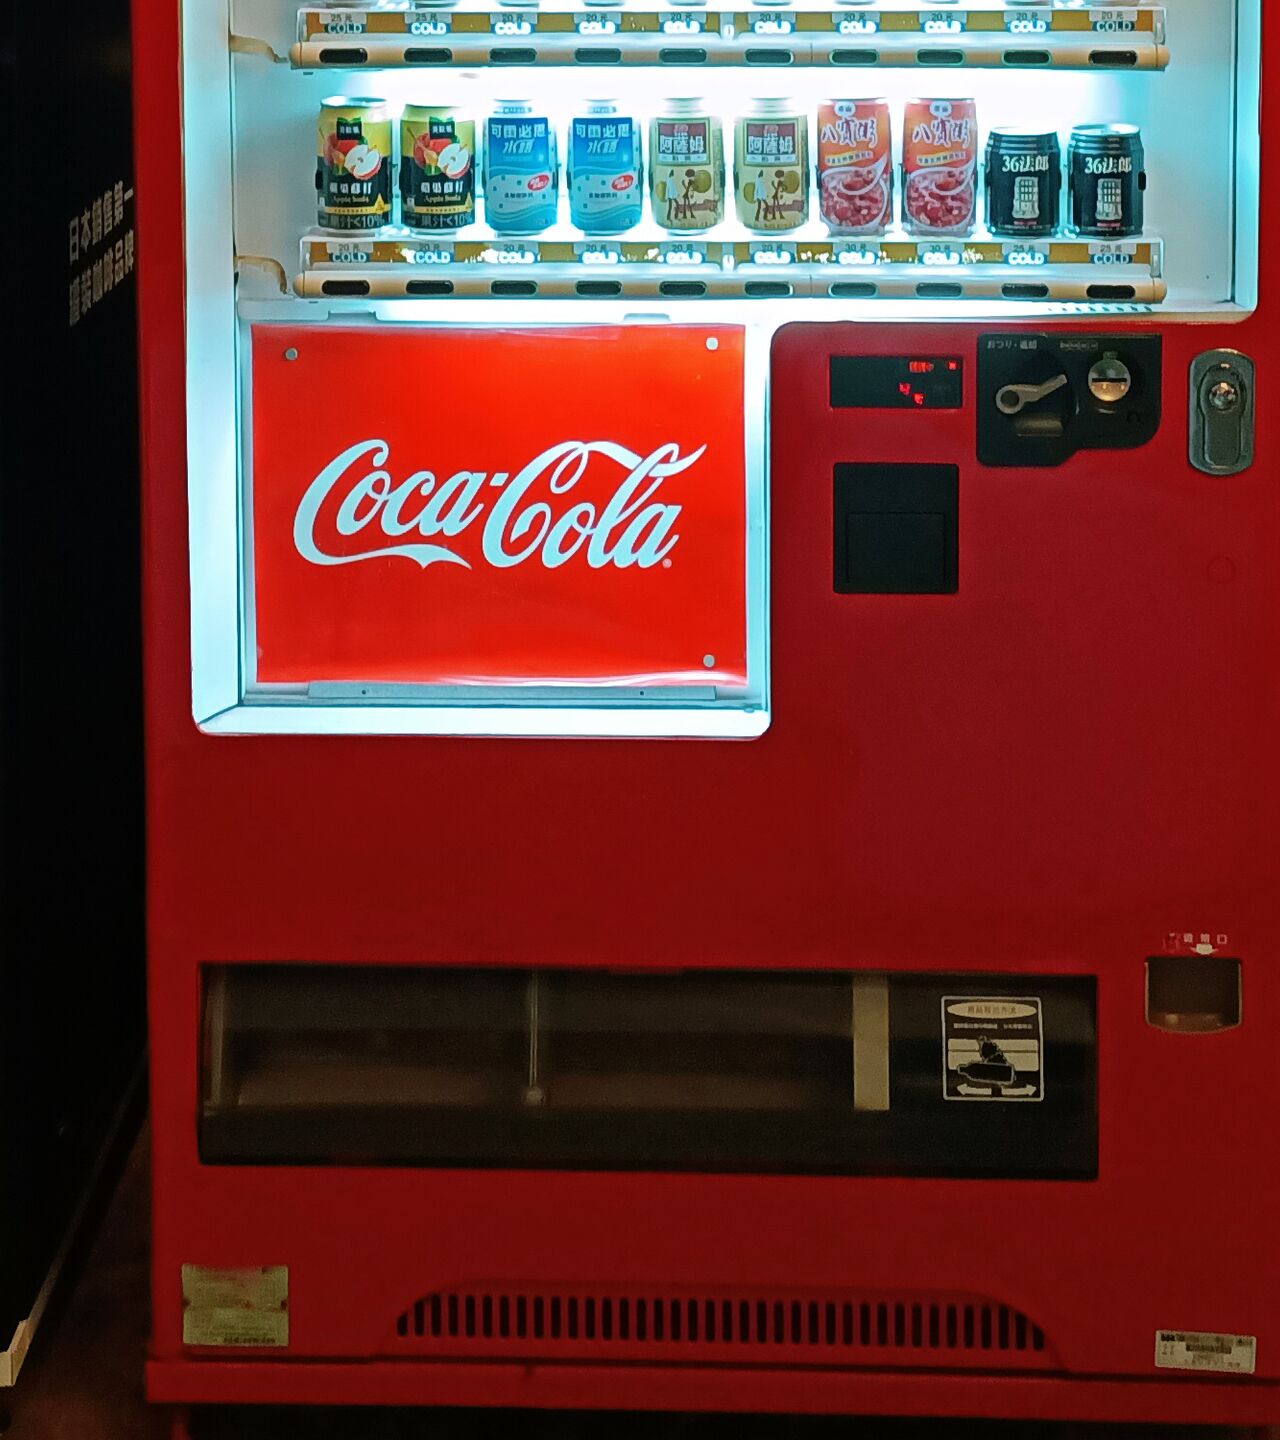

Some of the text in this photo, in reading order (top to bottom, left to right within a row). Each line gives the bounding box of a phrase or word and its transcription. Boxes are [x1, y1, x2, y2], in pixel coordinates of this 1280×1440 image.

[411, 22, 447, 34] COLD
[1009, 20, 1046, 33] COLD
[659, 132, 704, 153] 阿薩姆
[747, 133, 793, 154] 阿薩姆
[1001, 154, 1050, 174] 36法郎
[1084, 155, 1132, 174] 36法郎
[338, 243, 350, 252] 20
[332, 252, 367, 263] COLD
[415, 251, 451, 264] COLD
[1008, 252, 1044, 265] COLD
[1093, 254, 1129, 264] COLD
[292, 438, 708, 571] Coca-Cola
